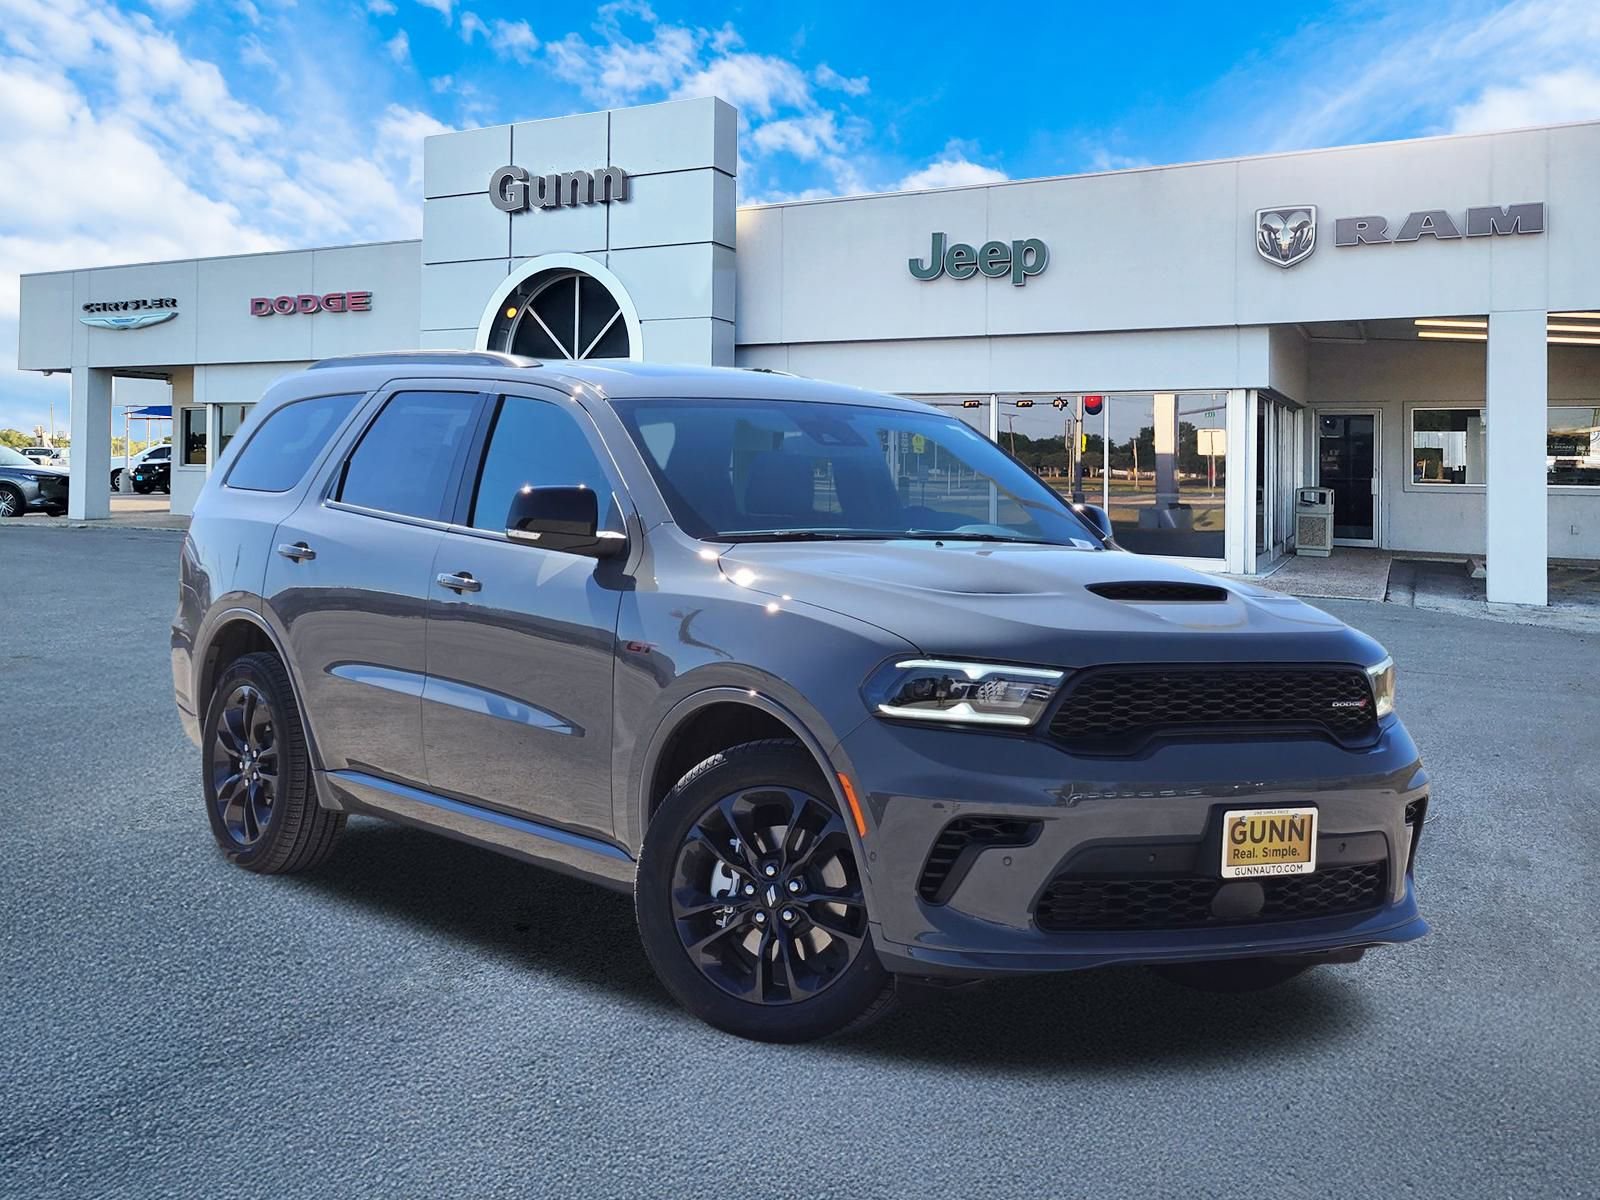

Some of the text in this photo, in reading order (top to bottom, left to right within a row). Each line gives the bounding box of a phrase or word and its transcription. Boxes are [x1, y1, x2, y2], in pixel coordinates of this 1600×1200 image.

[489, 165, 627, 212] Gunn
[1335, 202, 1545, 247] RAM
[908, 232, 1049, 286] Jeep
[82, 297, 178, 313] CHRYSLER
[250, 291, 373, 316] DODGE
[1231, 819, 1305, 844] GUNN
[1233, 845, 1300, 860] Real. Simple.
[1234, 864, 1303, 876] GUNNAUTO.COM
